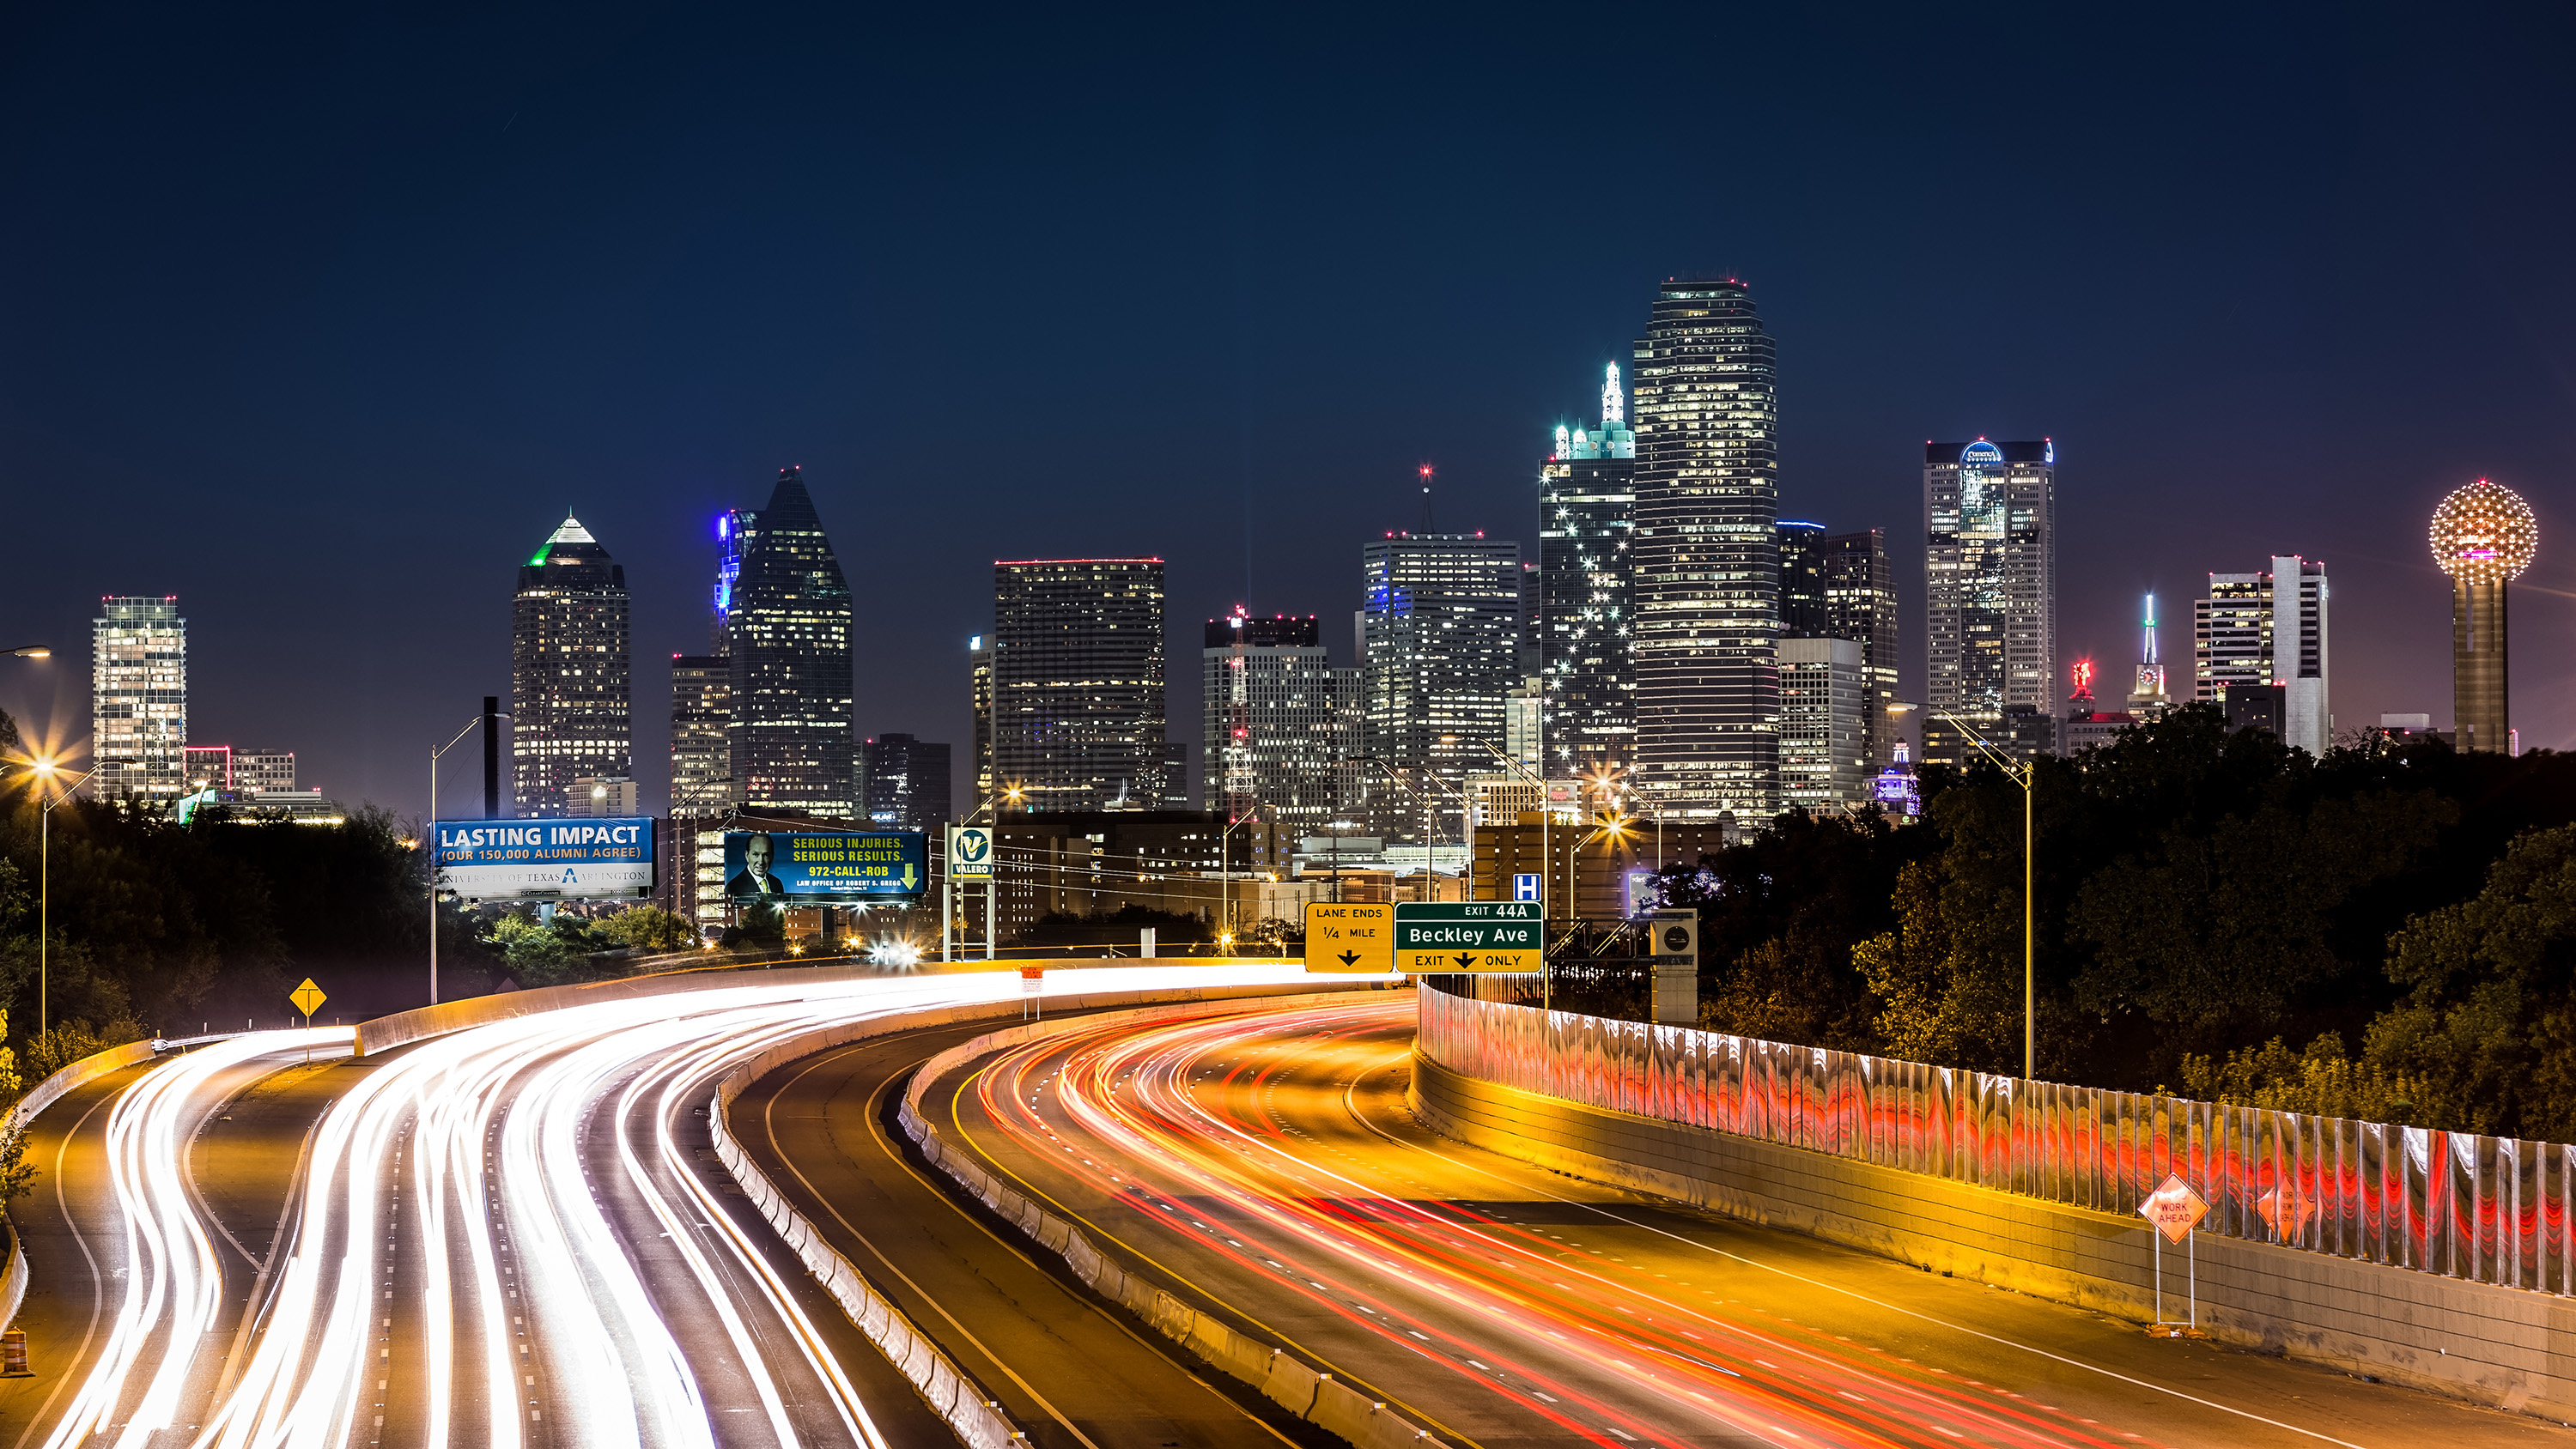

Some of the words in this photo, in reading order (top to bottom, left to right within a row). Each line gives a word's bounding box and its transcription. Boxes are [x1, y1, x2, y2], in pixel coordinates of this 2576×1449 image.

[441, 828, 542, 847] LASTING
[550, 826, 641, 846] IMPACT
[793, 838, 842, 848] SERIOUS
[847, 838, 903, 848] INJURIES.
[441, 851, 473, 863] (OUR
[479, 849, 530, 861] 150,000
[534, 848, 587, 859] ALUMNI
[592, 846, 641, 858] AGREE)
[793, 851, 845, 861] SERIOUS
[848, 851, 903, 861] RESULTS.
[809, 866, 889, 876] 972-CALL-ROB
[955, 864, 989, 874] VALERO
[508, 873, 523, 882] OF
[526, 871, 560, 882] TEXAS
[1517, 876, 1537, 899] H
[1316, 909, 1346, 918] LANE
[1352, 909, 1382, 918] ENDS
[1465, 906, 1489, 916] EXIT
[1496, 905, 1528, 918] 44A
[1349, 929, 1376, 937] MILE
[1409, 928, 1484, 945] Beckley
[1493, 929, 1528, 942] Ave
[1415, 956, 1444, 966] EXIT
[1485, 955, 1522, 966] ONLY
[2161, 1203, 2188, 1212] WORK
[2159, 1214, 2191, 1223] AHEAD
